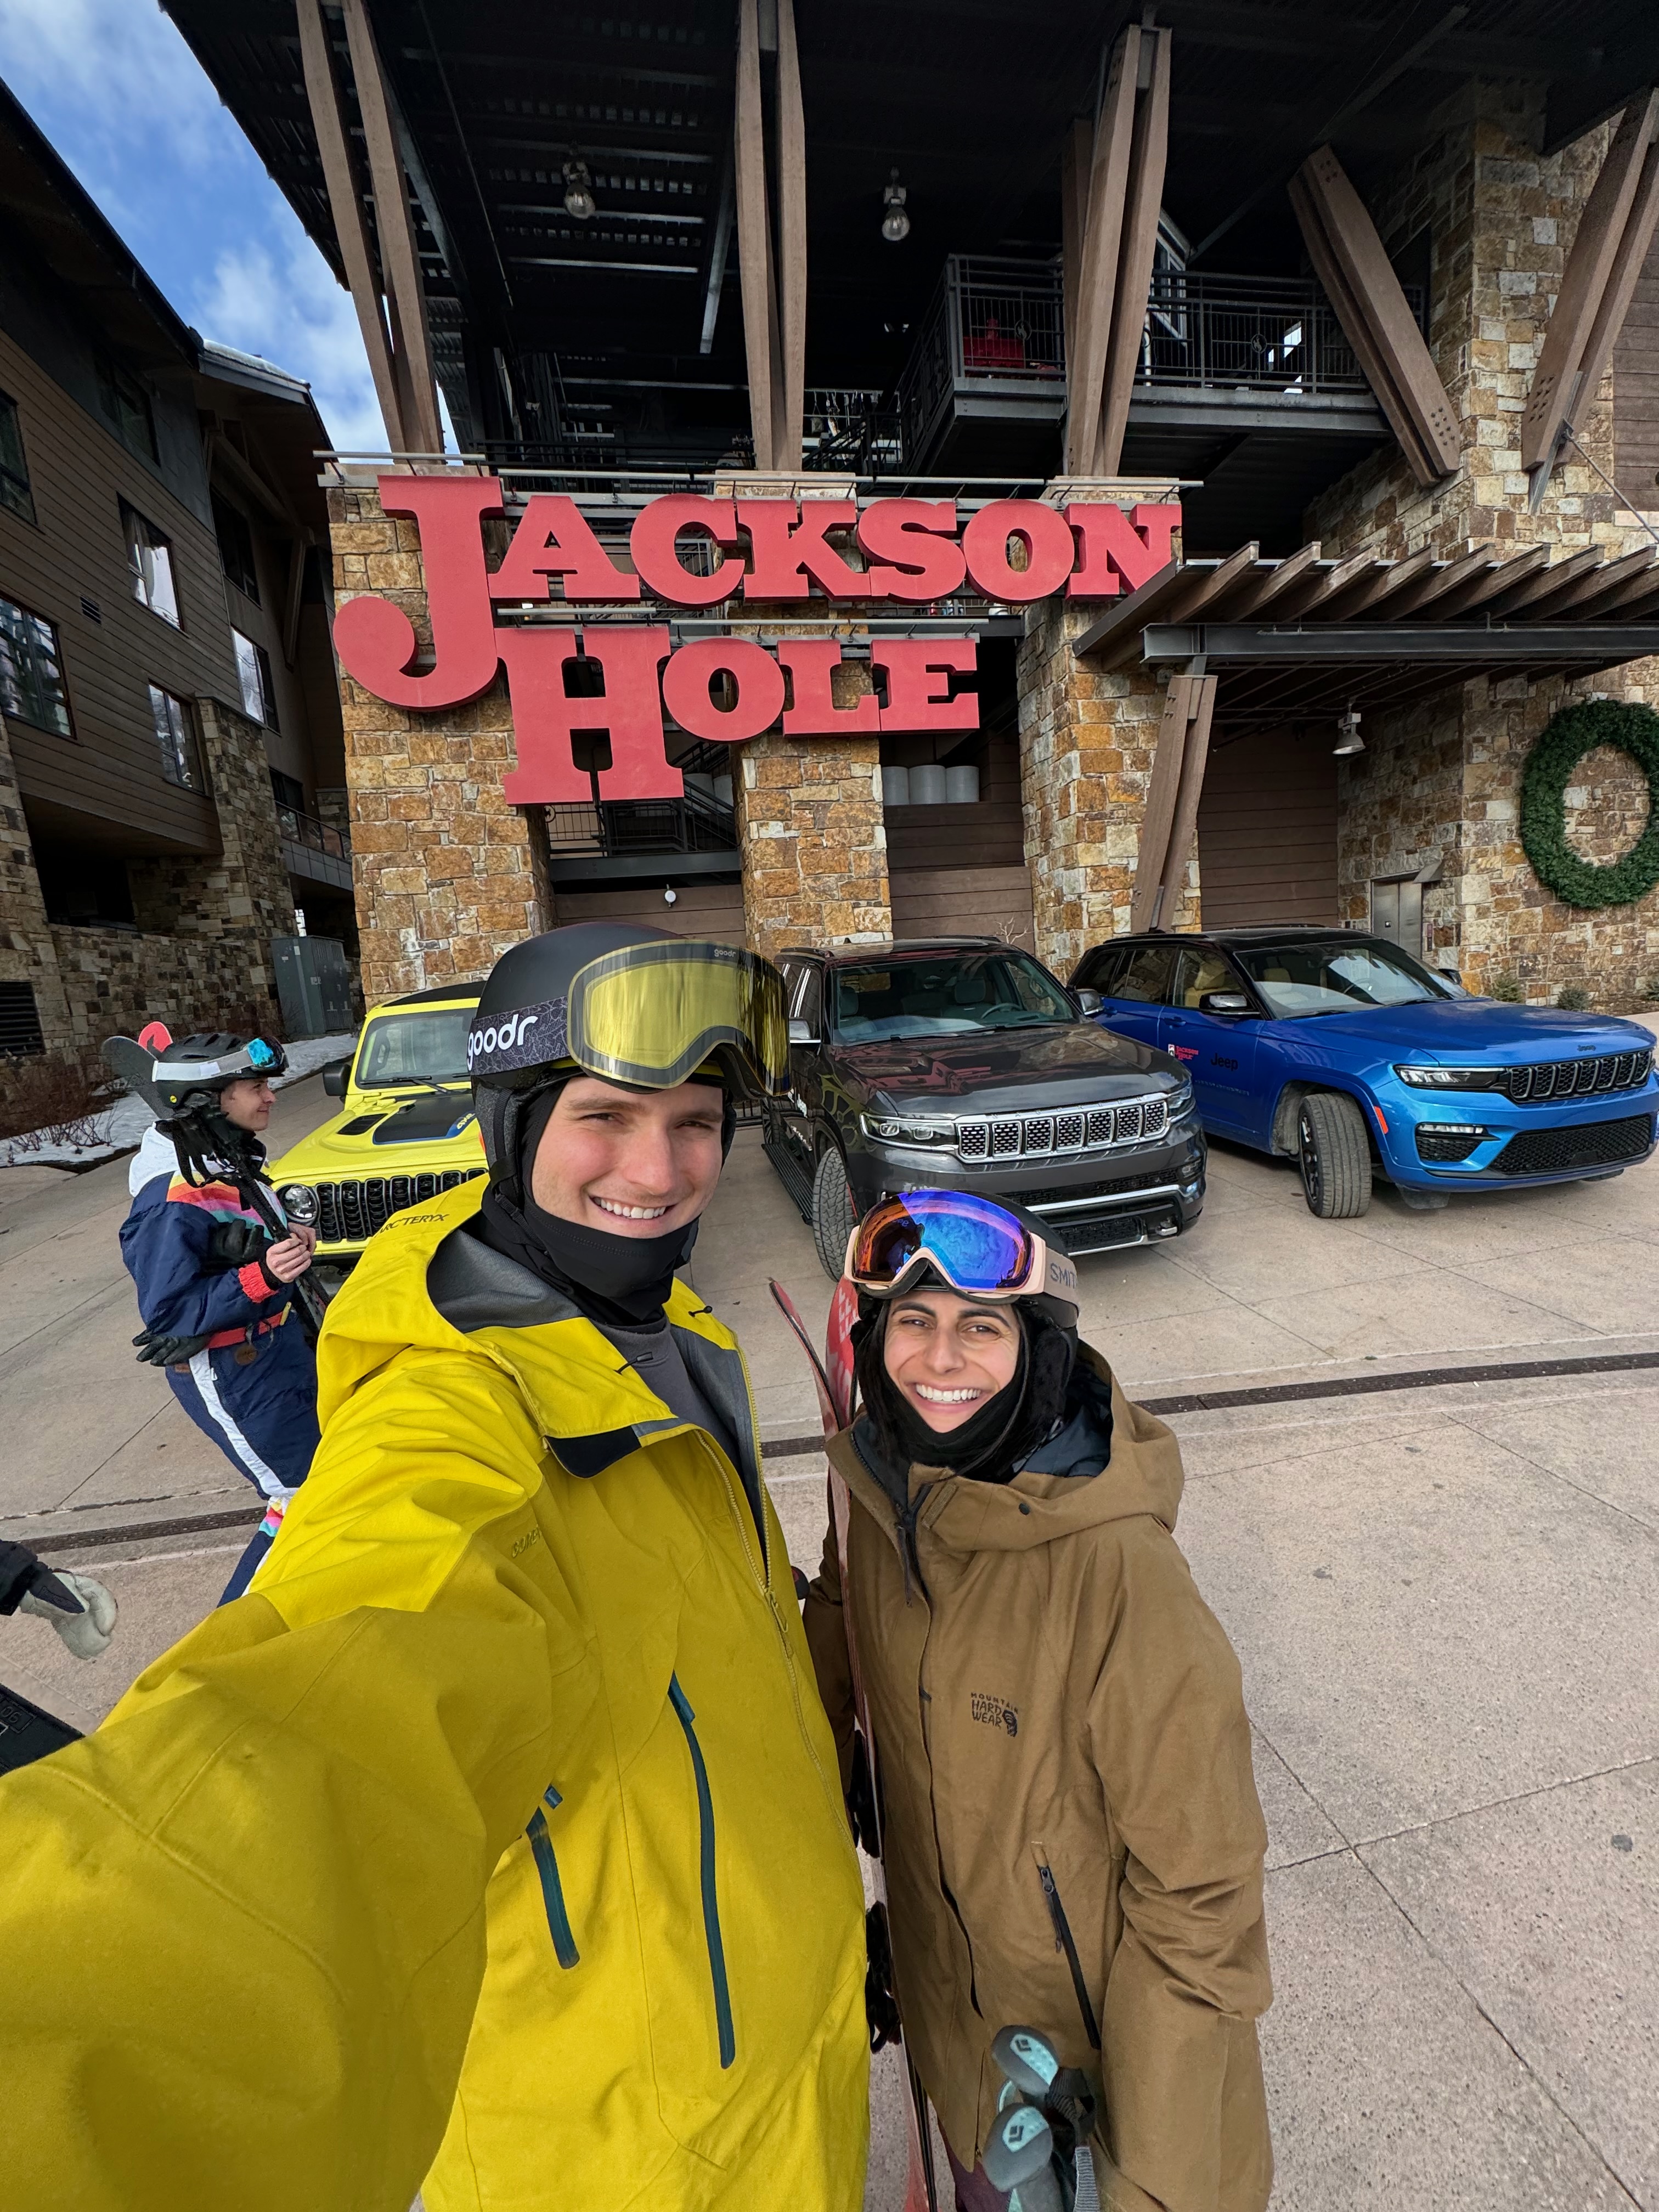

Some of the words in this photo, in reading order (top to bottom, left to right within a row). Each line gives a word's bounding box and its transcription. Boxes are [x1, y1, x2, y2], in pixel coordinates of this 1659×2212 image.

[332, 475, 1181, 712] JACKSON
[496, 625, 980, 805] HOLE
[714, 949, 736, 957] goodr
[467, 1014, 538, 1071] goodr
[1211, 1053, 1238, 1071] Jeep
[1050, 1262, 1077, 1289] SMIT
[971, 1692, 1018, 1714] MOUNTAIN
[972, 1700, 1002, 1717] HARD
[972, 1711, 1003, 1729] WEAR
